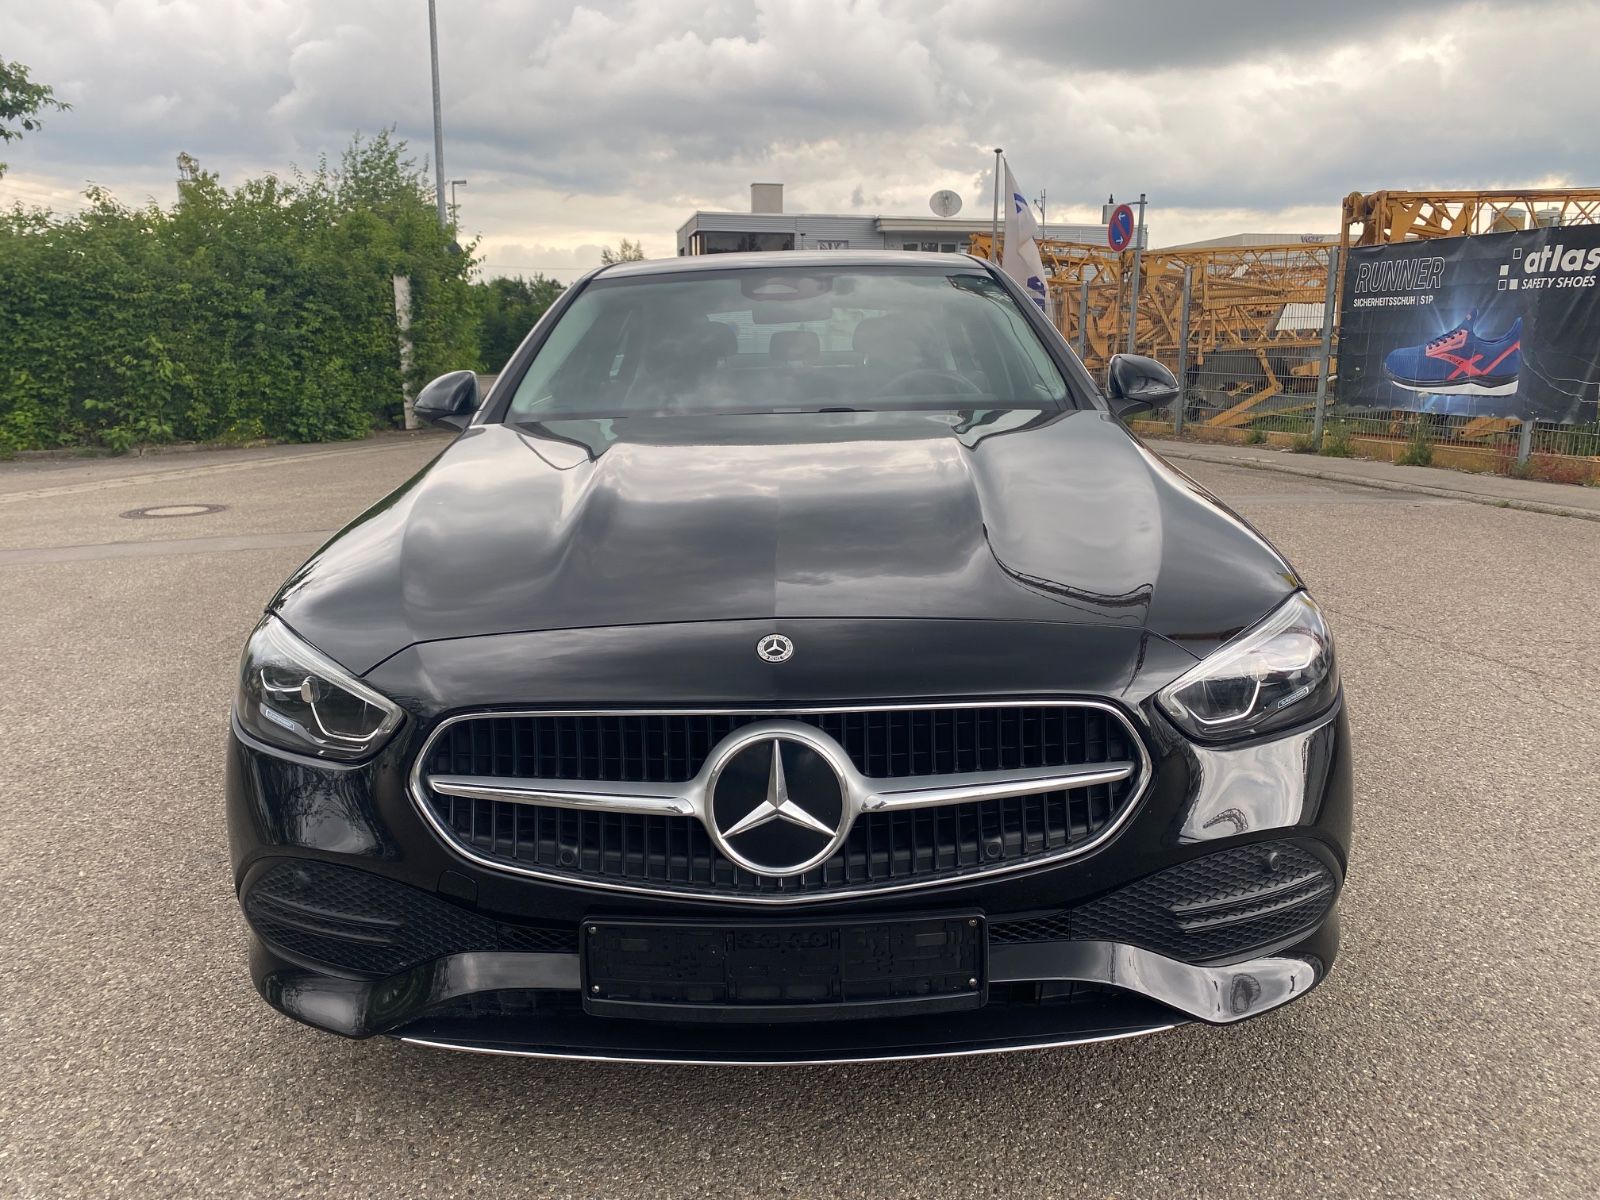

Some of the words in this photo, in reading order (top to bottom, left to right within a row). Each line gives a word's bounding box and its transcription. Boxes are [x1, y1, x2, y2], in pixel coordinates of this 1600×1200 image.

[1524, 244, 1600, 274] atlas
[1354, 256, 1446, 293] RUNNER
[1521, 277, 1557, 290] SAFETY
[1555, 275, 1597, 288] SHOES
[1353, 295, 1416, 307] SICHERHEITSSCHUH
[1420, 294, 1434, 305] S1P
